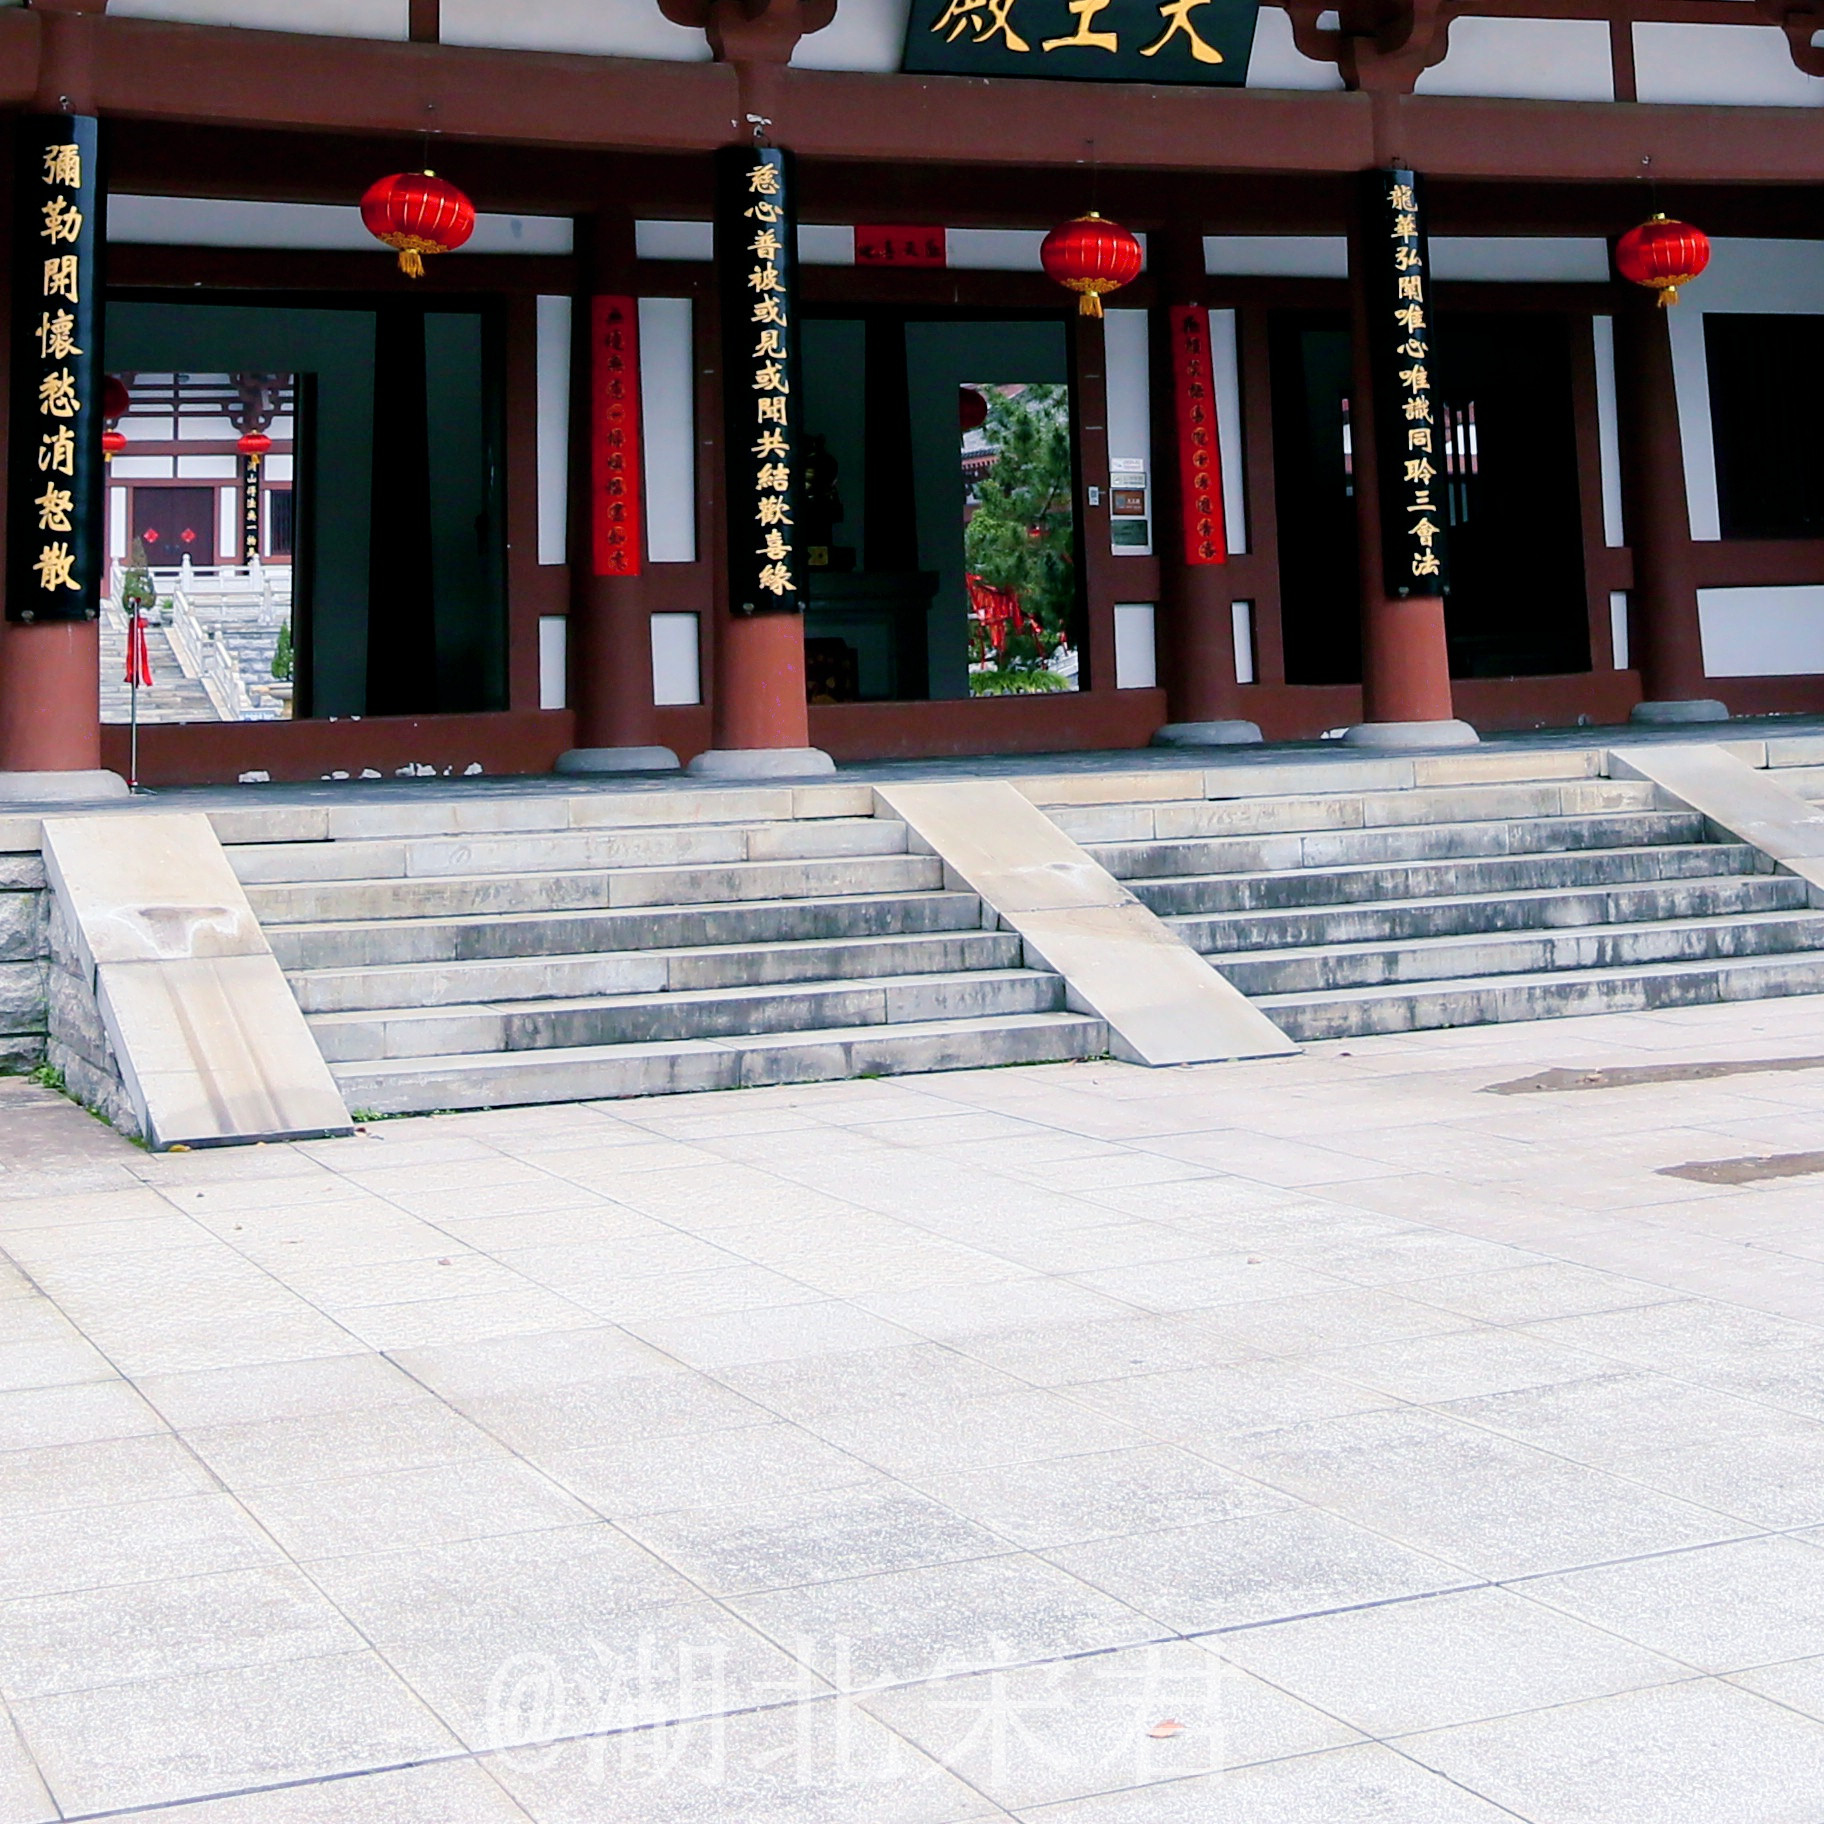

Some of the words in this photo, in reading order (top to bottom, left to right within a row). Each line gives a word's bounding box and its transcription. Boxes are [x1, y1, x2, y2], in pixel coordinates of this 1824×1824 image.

[32, 143, 84, 593] 彌勒開懷愁消怒散
[743, 162, 798, 597] 慈心普被或見或聞共結歡喜緣
